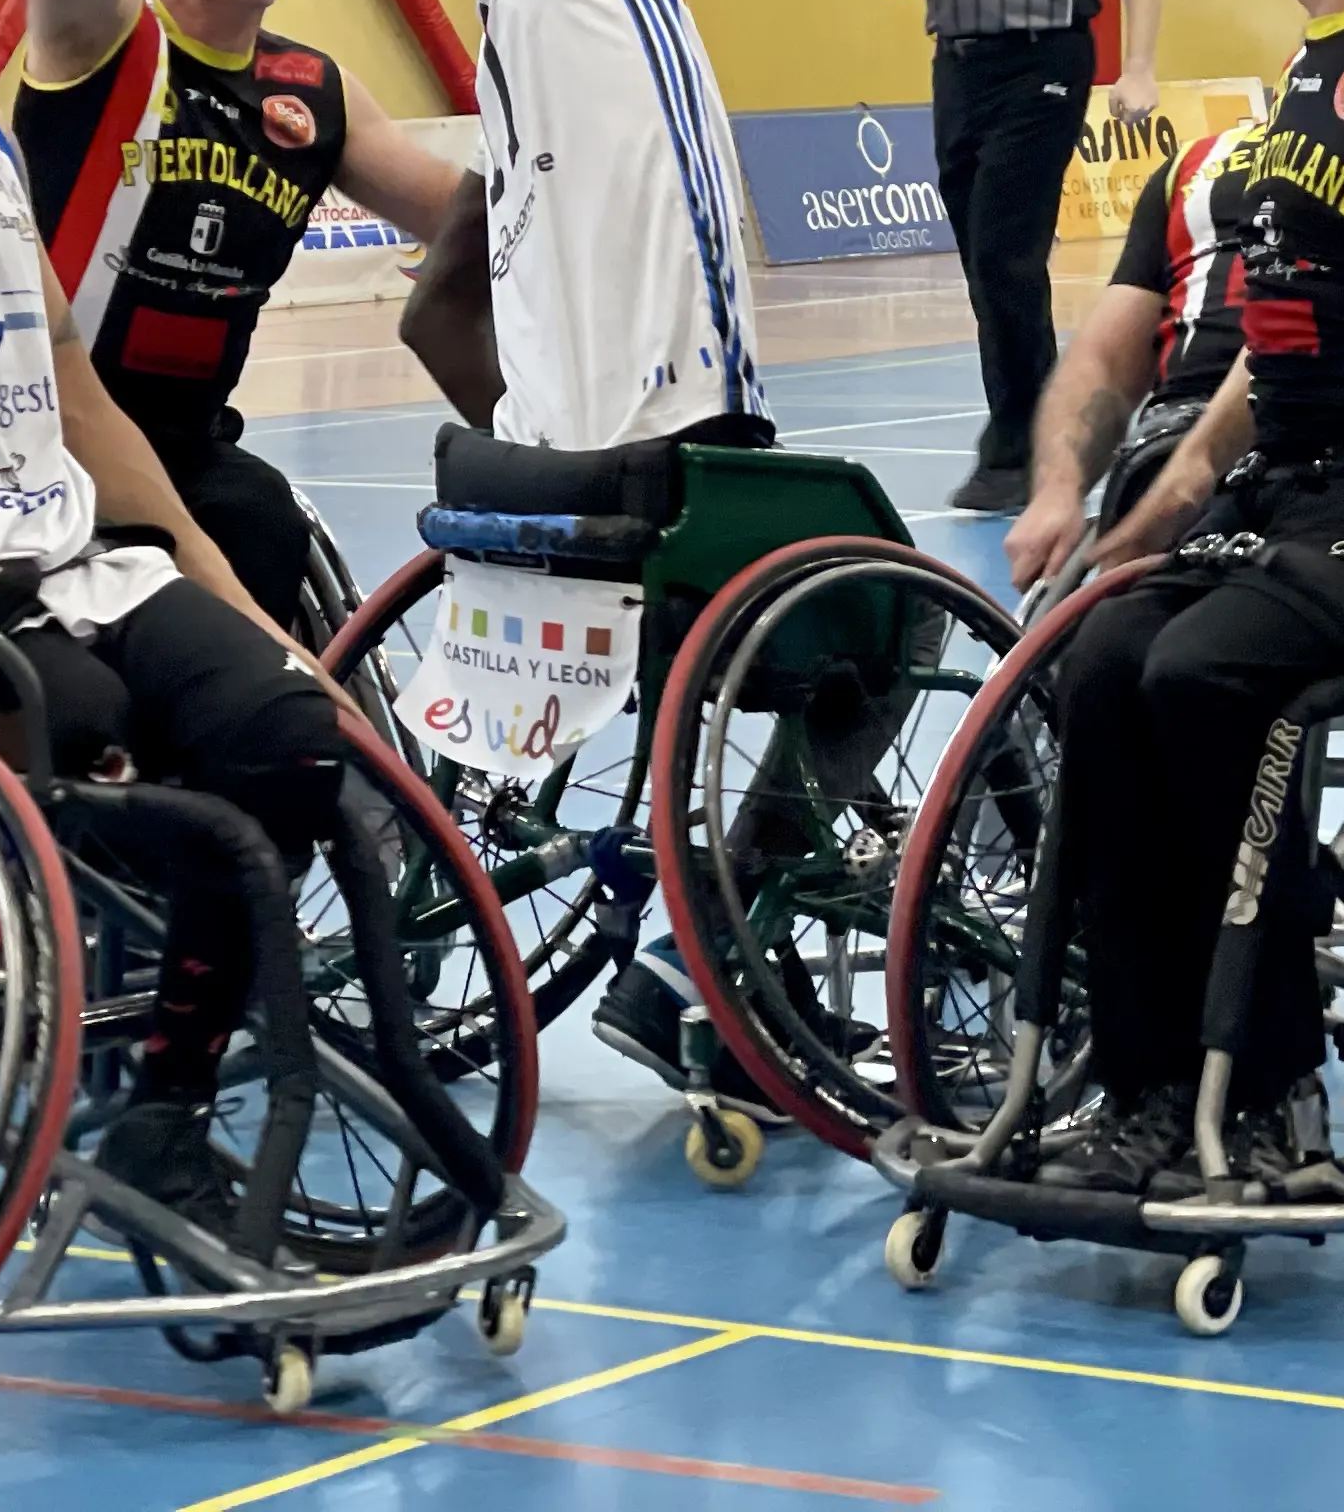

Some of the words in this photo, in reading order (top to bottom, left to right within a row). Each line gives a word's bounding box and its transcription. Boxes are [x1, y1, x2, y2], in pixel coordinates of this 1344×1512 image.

[121, 137, 310, 229] PUERTOLLANO
[868, 228, 933, 250] LOGISTIC
[442, 640, 520, 677] CASTILLA
[527, 658, 541, 680] Y
[547, 660, 611, 688] LEÓN
[424, 695, 473, 745] es
